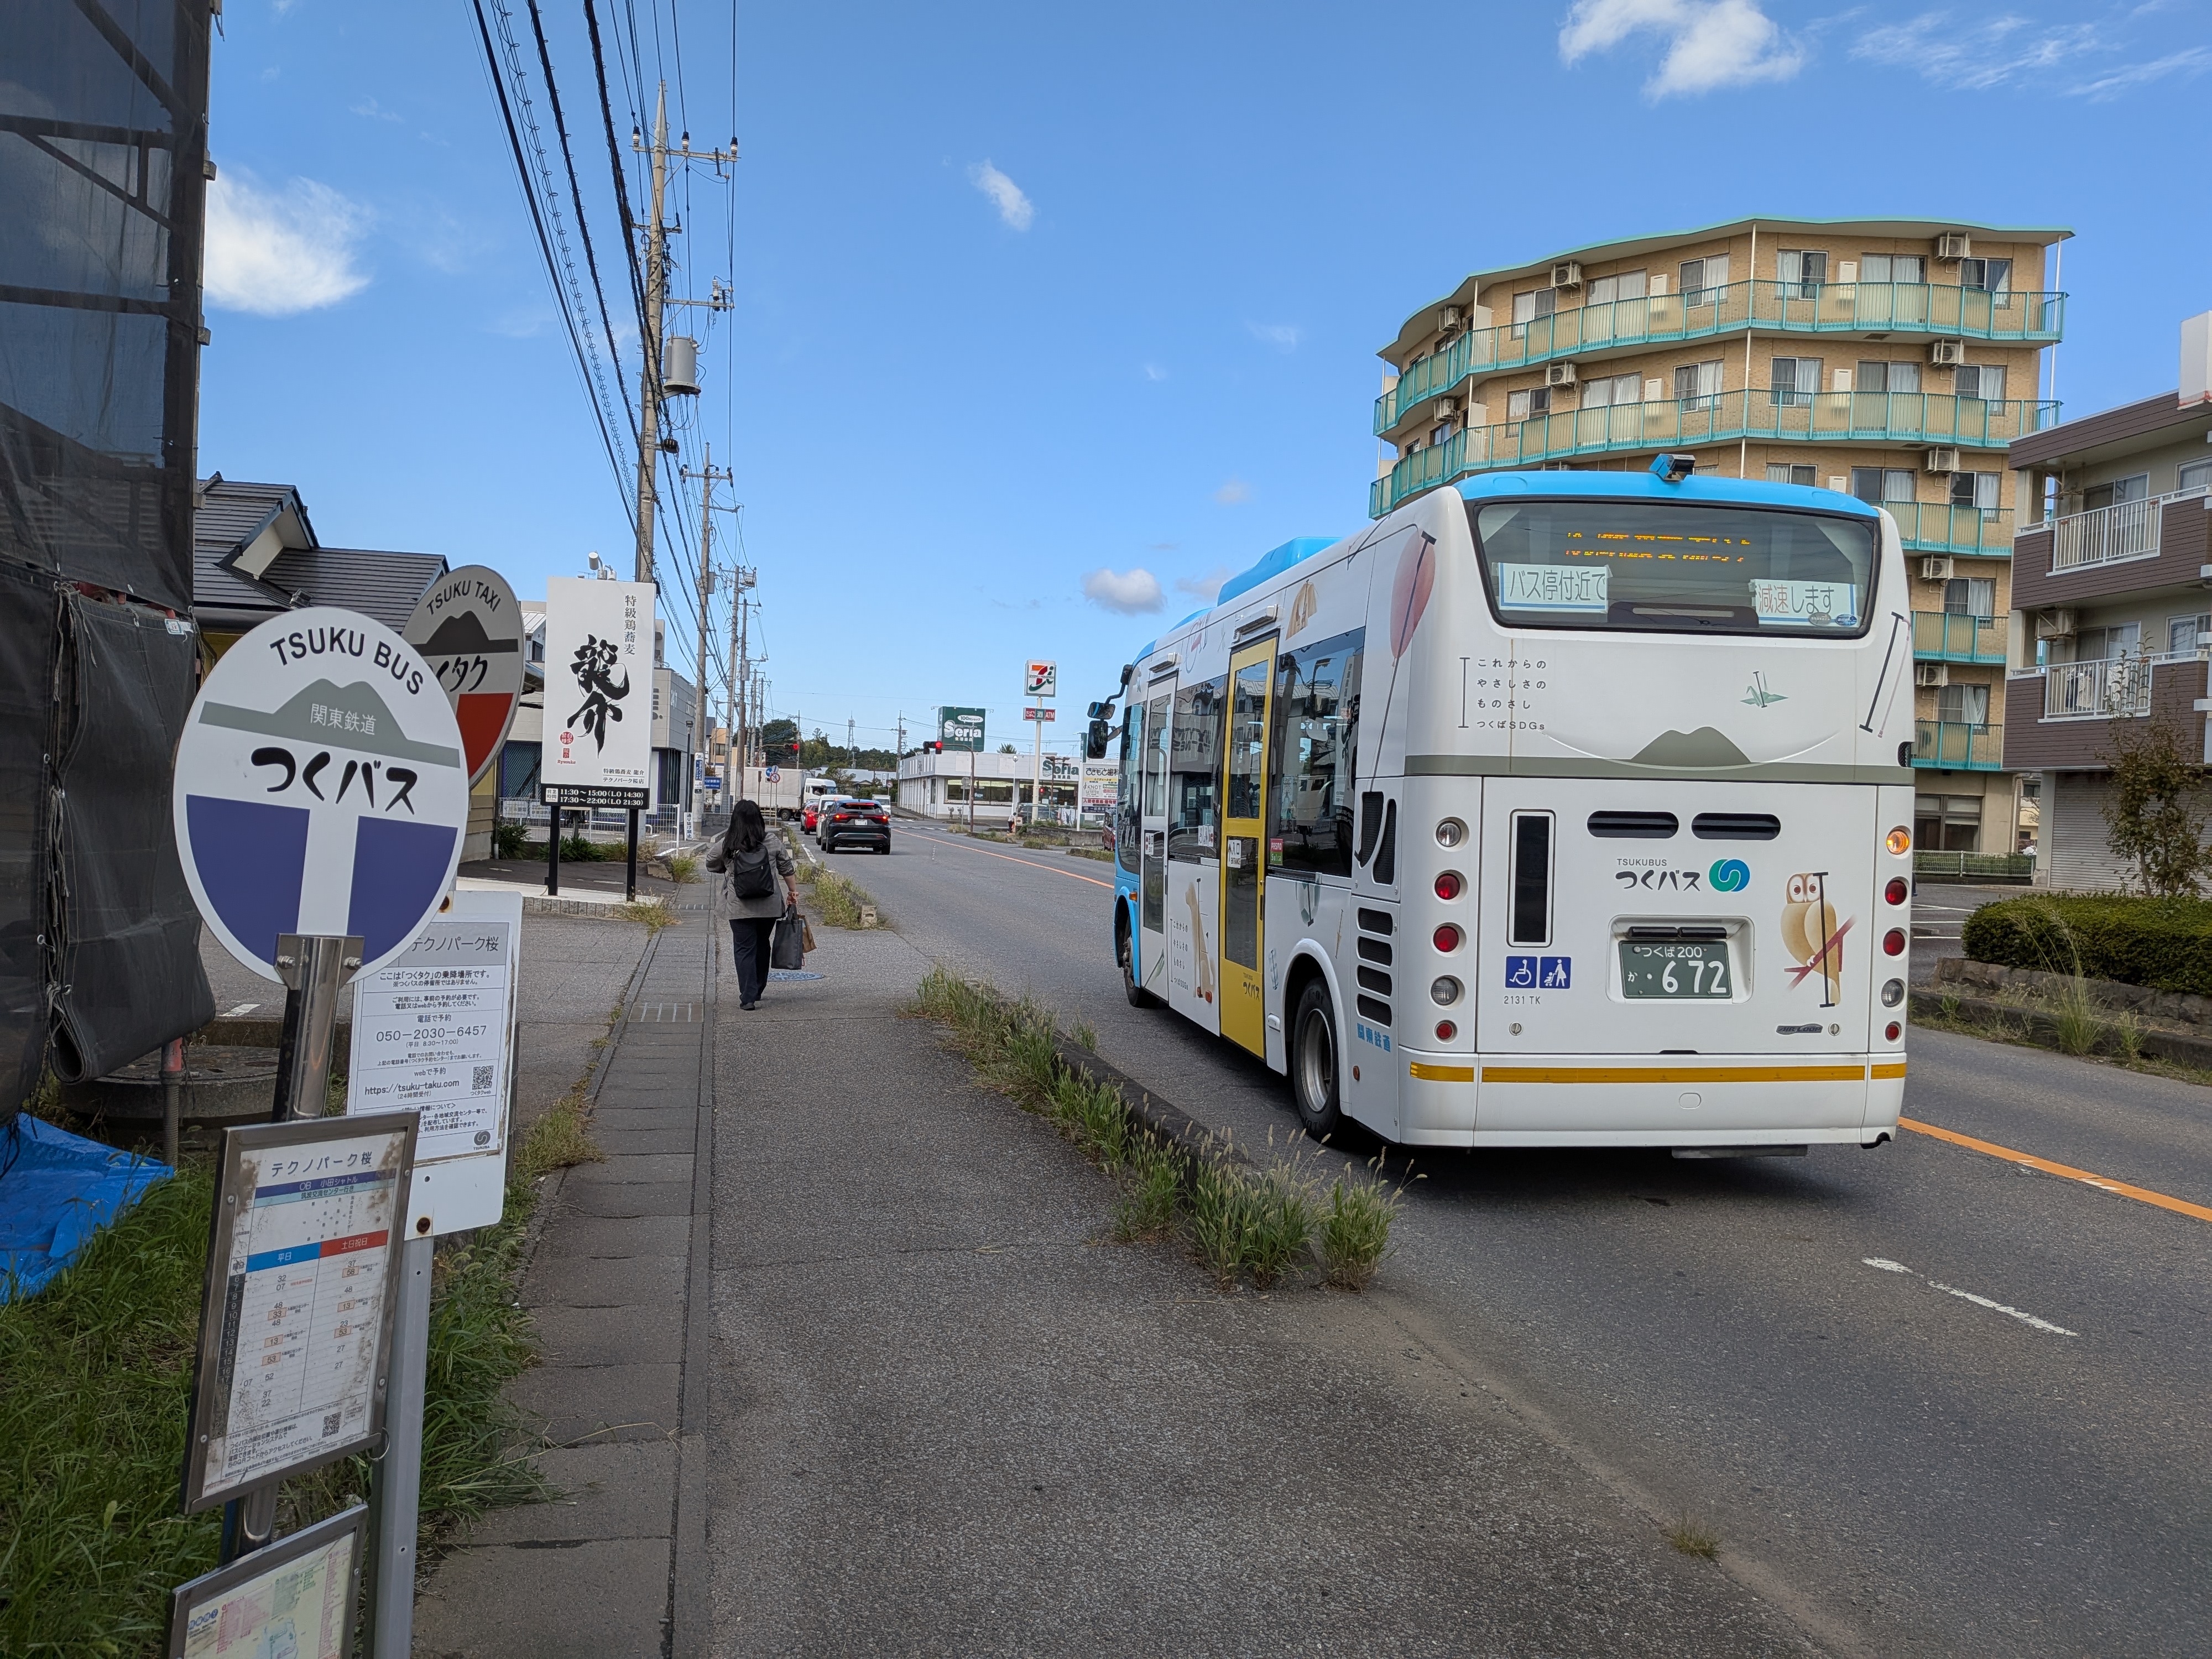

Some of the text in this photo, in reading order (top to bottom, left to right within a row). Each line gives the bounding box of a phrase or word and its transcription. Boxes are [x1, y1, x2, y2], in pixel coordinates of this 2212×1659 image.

[1510, 570, 1605, 601] バス停付近で
[426, 580, 501, 615] TSUKU TAXI
[1759, 584, 1834, 614] 減速します
[624, 594, 637, 655] 特級鶏蕎麦
[270, 627, 424, 695] TSUKU BUS
[1478, 658, 1546, 669] これからの
[428, 655, 488, 692] くタク
[1477, 679, 1546, 689] やさしさの
[1478, 698, 1531, 709] ものさし
[310, 703, 377, 735] 関東鉄道
[944, 720, 982, 738] Seria
[1477, 721, 1545, 730] つくばSDGs
[1042, 760, 1079, 776] Seria
[251, 747, 418, 815] つくバス
[1616, 858, 1667, 867] TSUKUBUS
[1615, 869, 1700, 891] つくバス
[1173, 921, 1188, 933] これからの
[412, 936, 499, 952] テクノパーク桜
[1173, 939, 1188, 952] やさしさの
[1173, 957, 1185, 969] ものさし
[380, 969, 490, 980] ここは「つくタク」の乗降場所です。
[1243, 982, 1260, 1001] つくバス
[1504, 995, 1540, 1004] 2131 TK
[417, 1014, 451, 1023] 電話で予約
[1357, 1022, 1391, 1053] 関東鉄道
[414, 1067, 446, 1076] webで予約
[365, 1080, 460, 1095] https://tsuku-taku.com
[272, 1151, 372, 1177] テクノパーク桜
[299, 1176, 358, 1191] OB 小田シャトル
[341, 1237, 368, 1250] 土日祝日
[278, 1251, 291, 1262] 平日
[226, 1339, 234, 1347] 13
[337, 1345, 345, 1353] 27
[334, 1361, 343, 1369] 27
[243, 1379, 253, 1387] 07
[265, 1373, 274, 1381] 52
[263, 1390, 272, 1398] 37
[262, 1399, 271, 1407] 22
